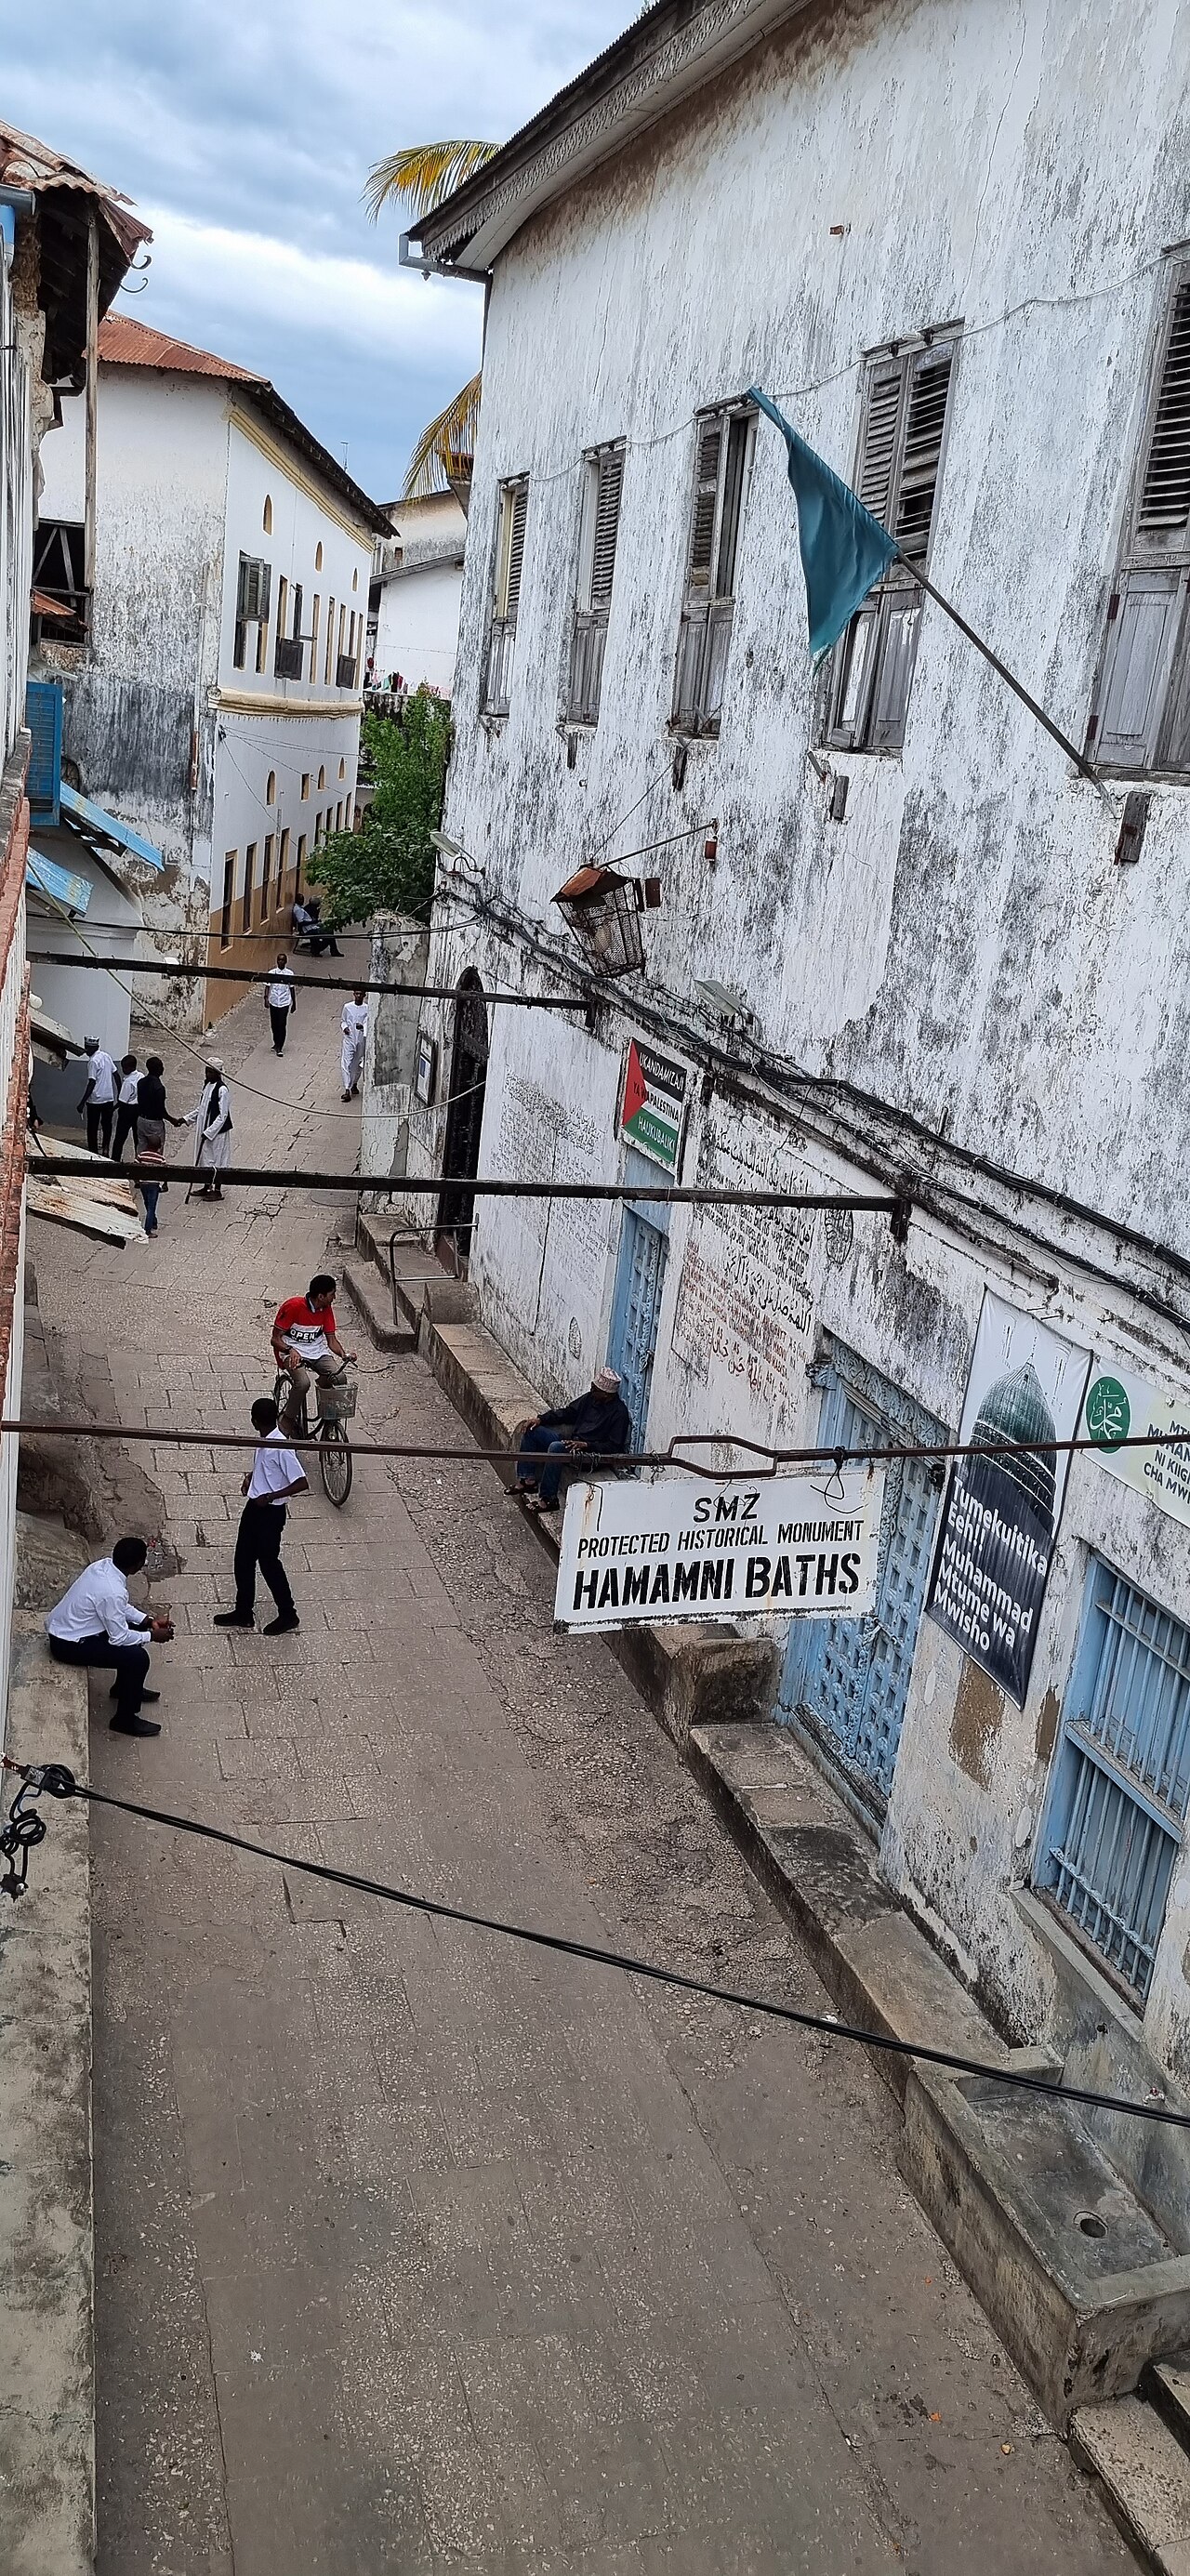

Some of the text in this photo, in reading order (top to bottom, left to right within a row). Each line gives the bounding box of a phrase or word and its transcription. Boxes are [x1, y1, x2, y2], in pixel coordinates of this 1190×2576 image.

[640, 1052, 684, 1091] UKANDAMIZAJI
[638, 1116, 675, 1153] HAUKUBALIKI
[290, 1329, 315, 1340] OPEN
[1144, 1462, 1162, 1486] CHA
[1155, 1450, 1166, 1467] NI
[693, 1493, 760, 1523] SMZ
[947, 1500, 985, 1551] Eeh!!
[954, 1476, 1049, 1577] Tumekuitika
[577, 1520, 865, 1558] PROTECTED HISTORICAL MONUMENT
[573, 1552, 861, 1610] HAMAMNI BATHS
[943, 1534, 1034, 1633] Muhammad
[933, 1580, 990, 1651] Mwisho
[938, 1557, 1017, 1648] Mtume wa
